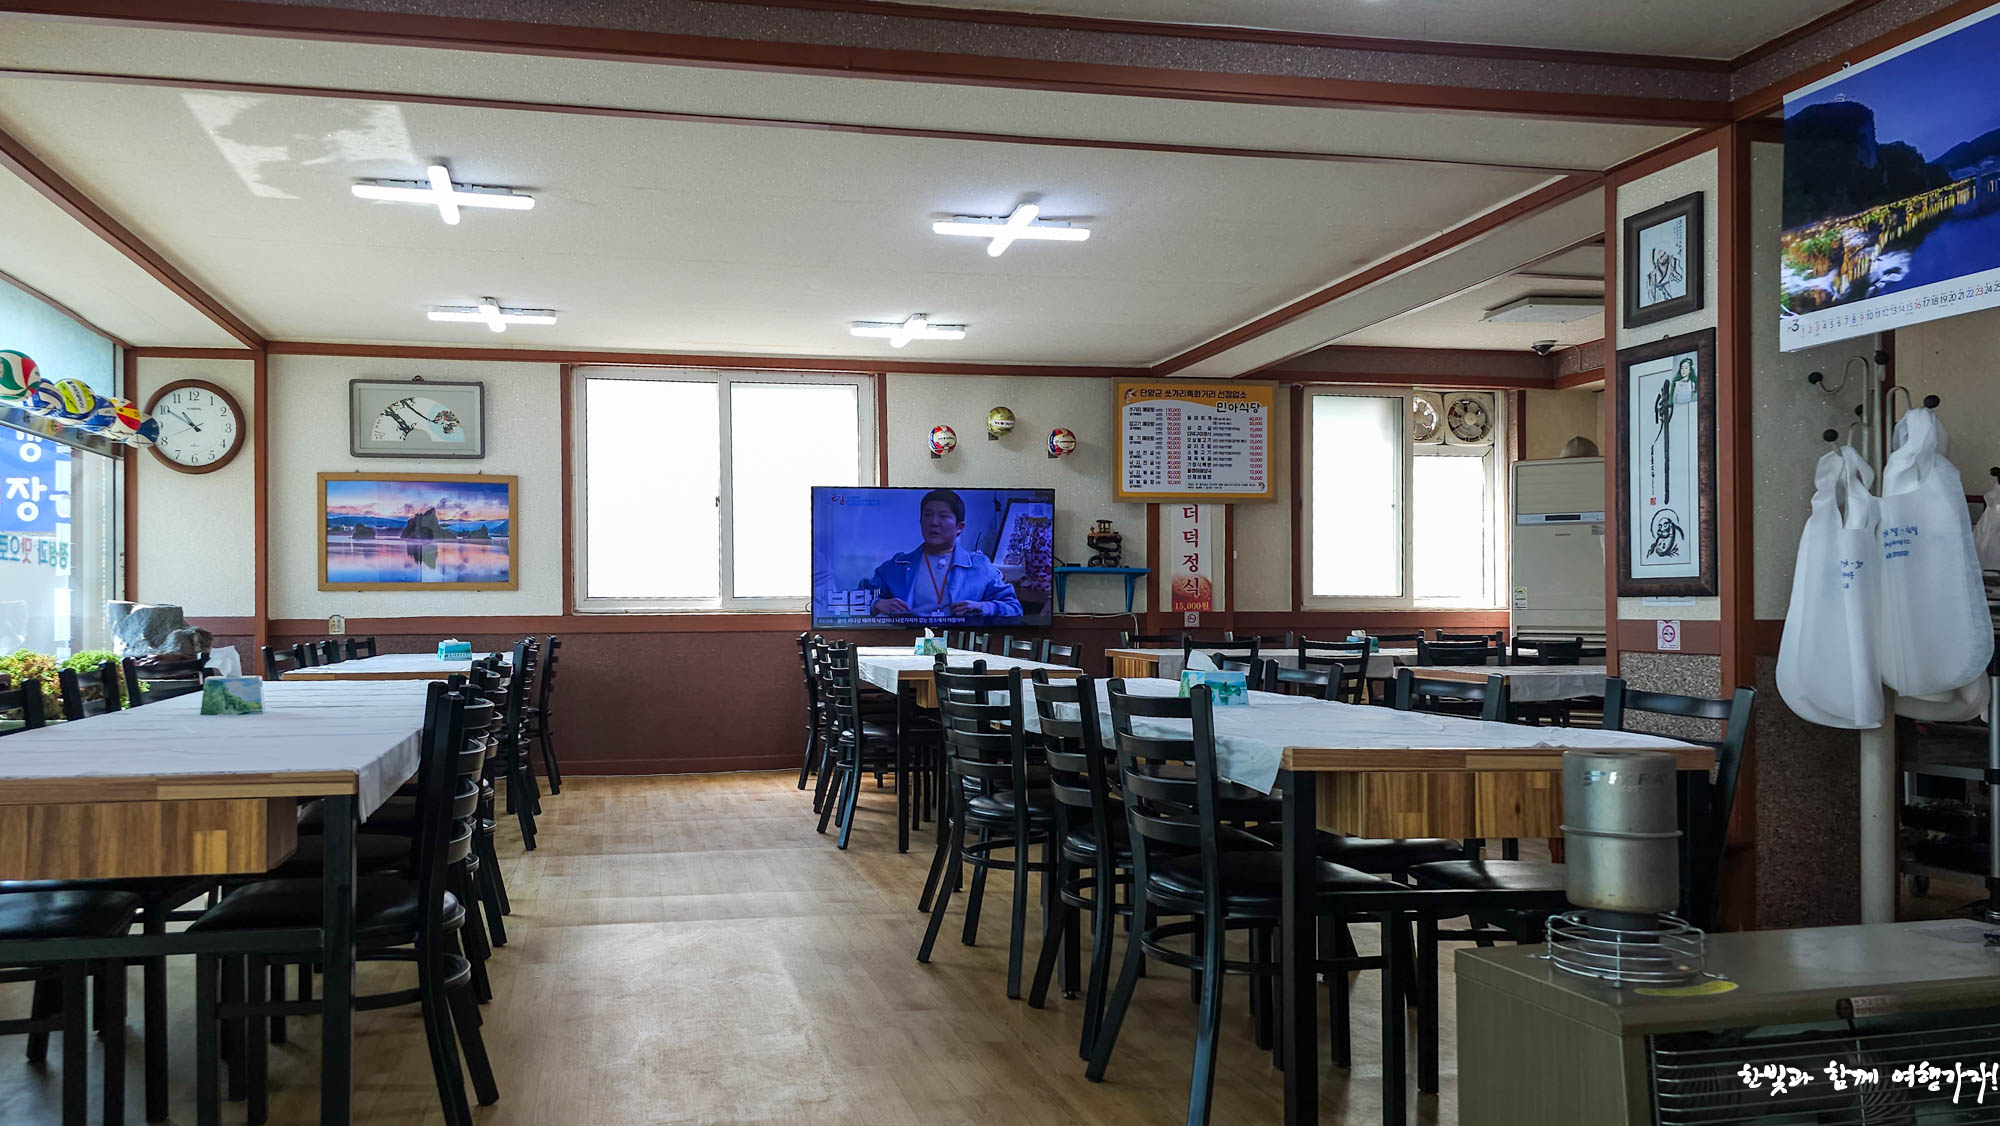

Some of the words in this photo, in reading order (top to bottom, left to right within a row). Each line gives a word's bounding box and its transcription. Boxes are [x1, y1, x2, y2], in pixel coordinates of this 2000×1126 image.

[1866, 312, 1873, 320] 10
[1890, 307, 1897, 315] 13
[1906, 303, 1913, 311] 15
[1915, 301, 1921, 310] 16
[1923, 300, 1930, 308] 17
[1931, 297, 1939, 305] 18
[1940, 296, 1947, 304] 19
[1948, 294, 1956, 302] 20
[1958, 292, 1964, 300] 21
[1966, 289, 1974, 298] 22
[1975, 287, 1983, 296] 23
[1984, 285, 1993, 294] 24
[1993, 283, 2000, 292] 25
[172, 393, 181, 404] 11
[189, 391, 200, 401] 12
[1140, 388, 1163, 398] 단양군
[210, 395, 214, 406] 1
[160, 405, 170, 415] 10
[220, 406, 227, 417] 2
[1216, 401, 1261, 414] 민아식당
[225, 423, 232, 433] 3
[160, 436, 168, 446] 8
[219, 438, 226, 449] 4
[175, 449, 181, 460] 7
[191, 453, 198, 464] 6
[207, 450, 215, 460] 5
[1182, 504, 1199, 597] 더덕정식
[827, 589, 873, 616] 부담
[1175, 602, 1209, 611] 15,000원
